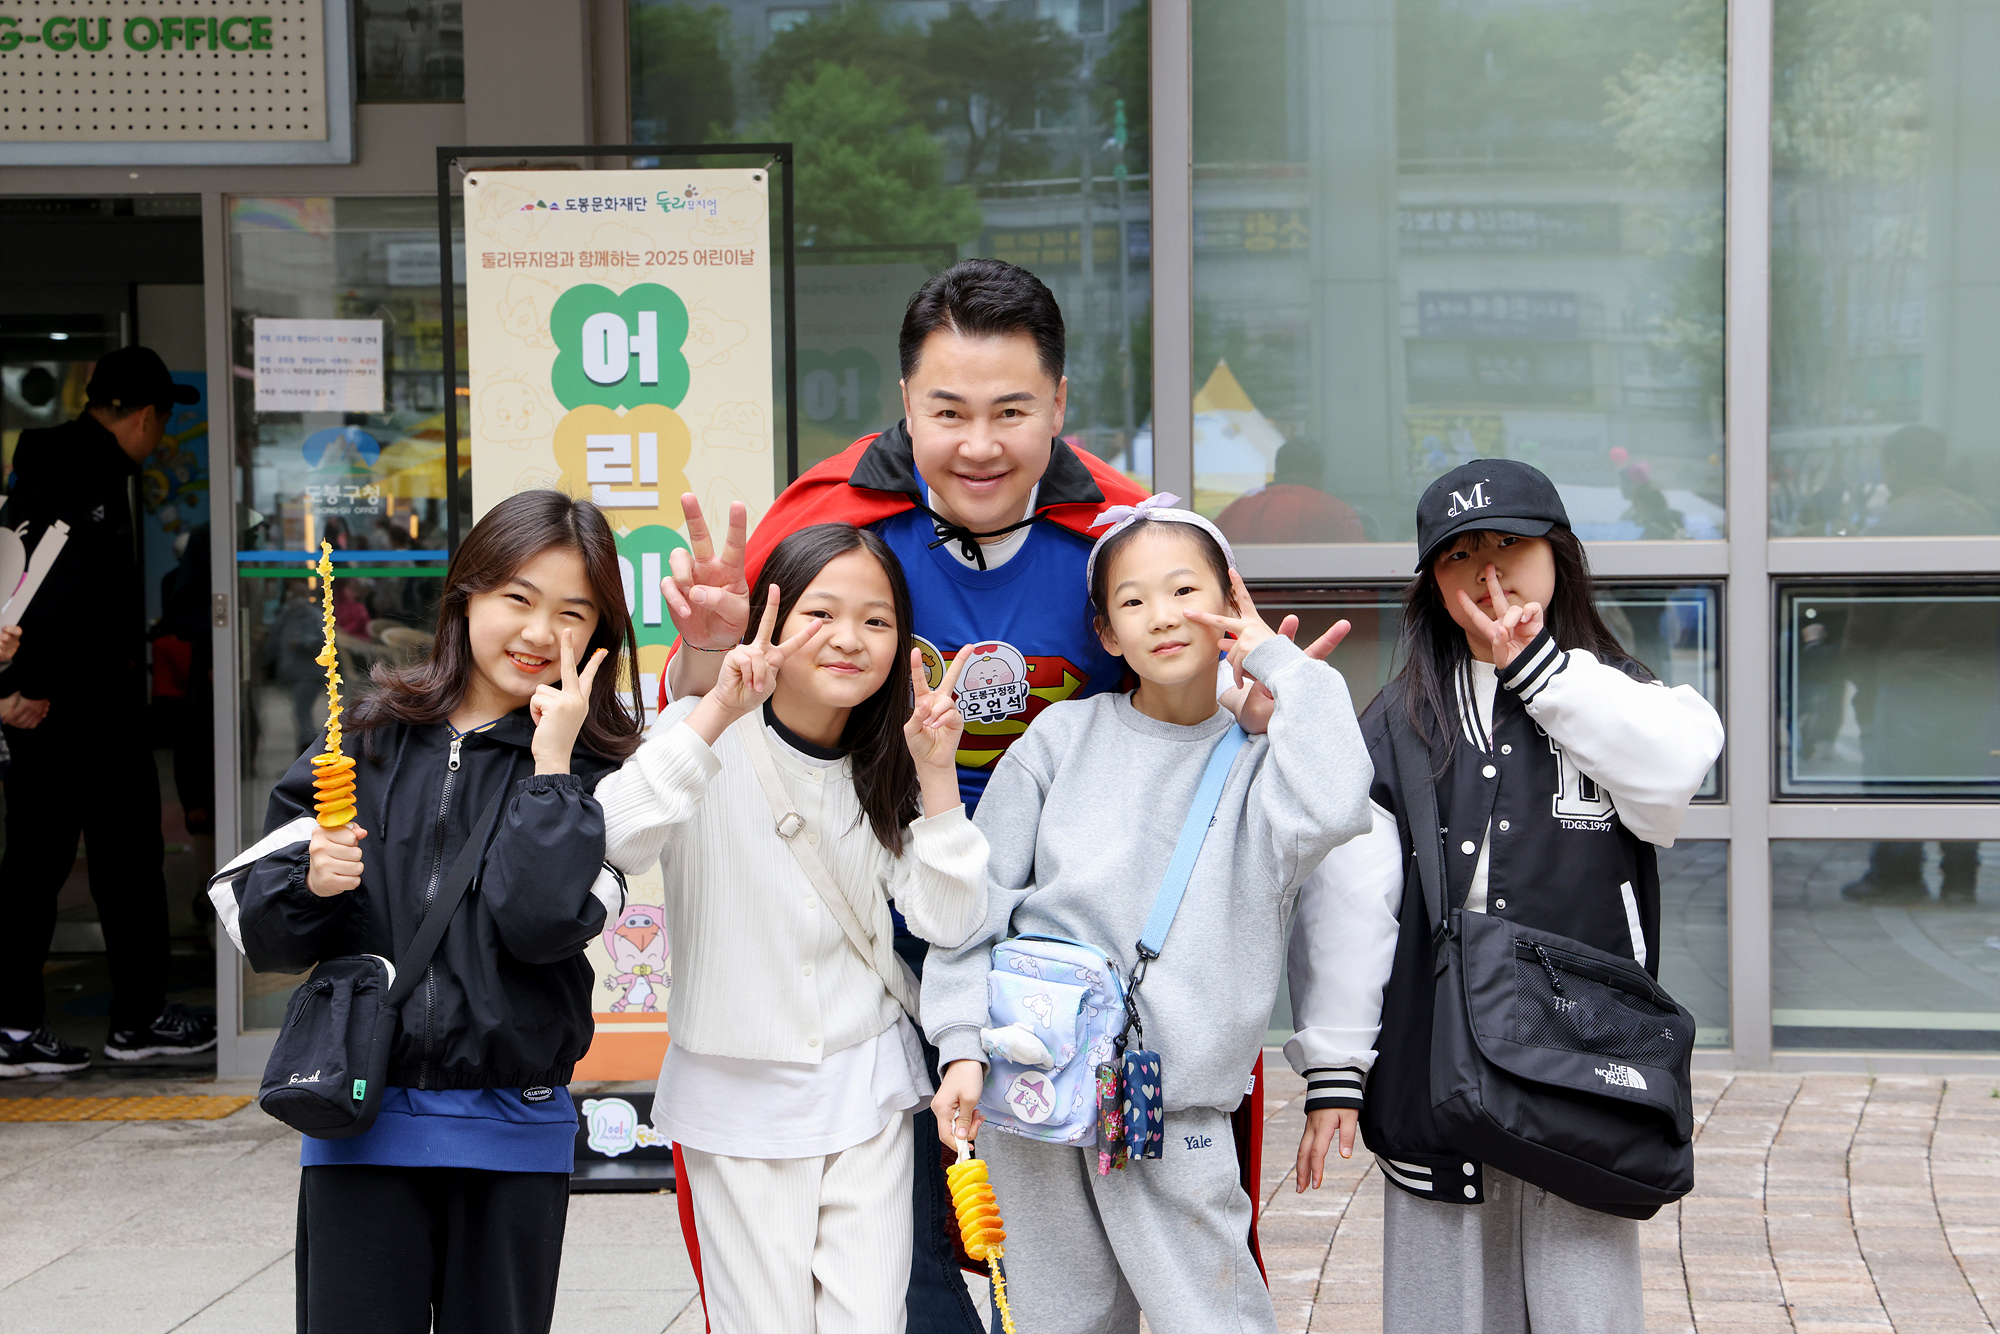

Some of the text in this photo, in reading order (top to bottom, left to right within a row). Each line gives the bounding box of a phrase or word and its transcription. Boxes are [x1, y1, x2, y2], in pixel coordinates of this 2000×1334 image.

[123, 16, 273, 52] OFFICE
[565, 196, 648, 213] 도봉문화재단
[481, 249, 756, 269] 둘리뮤지엄과 함께하는 2025 어린이날
[303, 484, 380, 506] 도봉구청
[354, 506, 379, 515] OFFICE
[969, 684, 1017, 701] 도봉구청장
[1560, 819, 1612, 833] TDGS.1997
[1594, 1067, 1629, 1081] NORTH
[1608, 1062, 1629, 1074] THE
[1605, 1077, 1631, 1088] FACE
[1183, 1134, 1213, 1151] Yale
